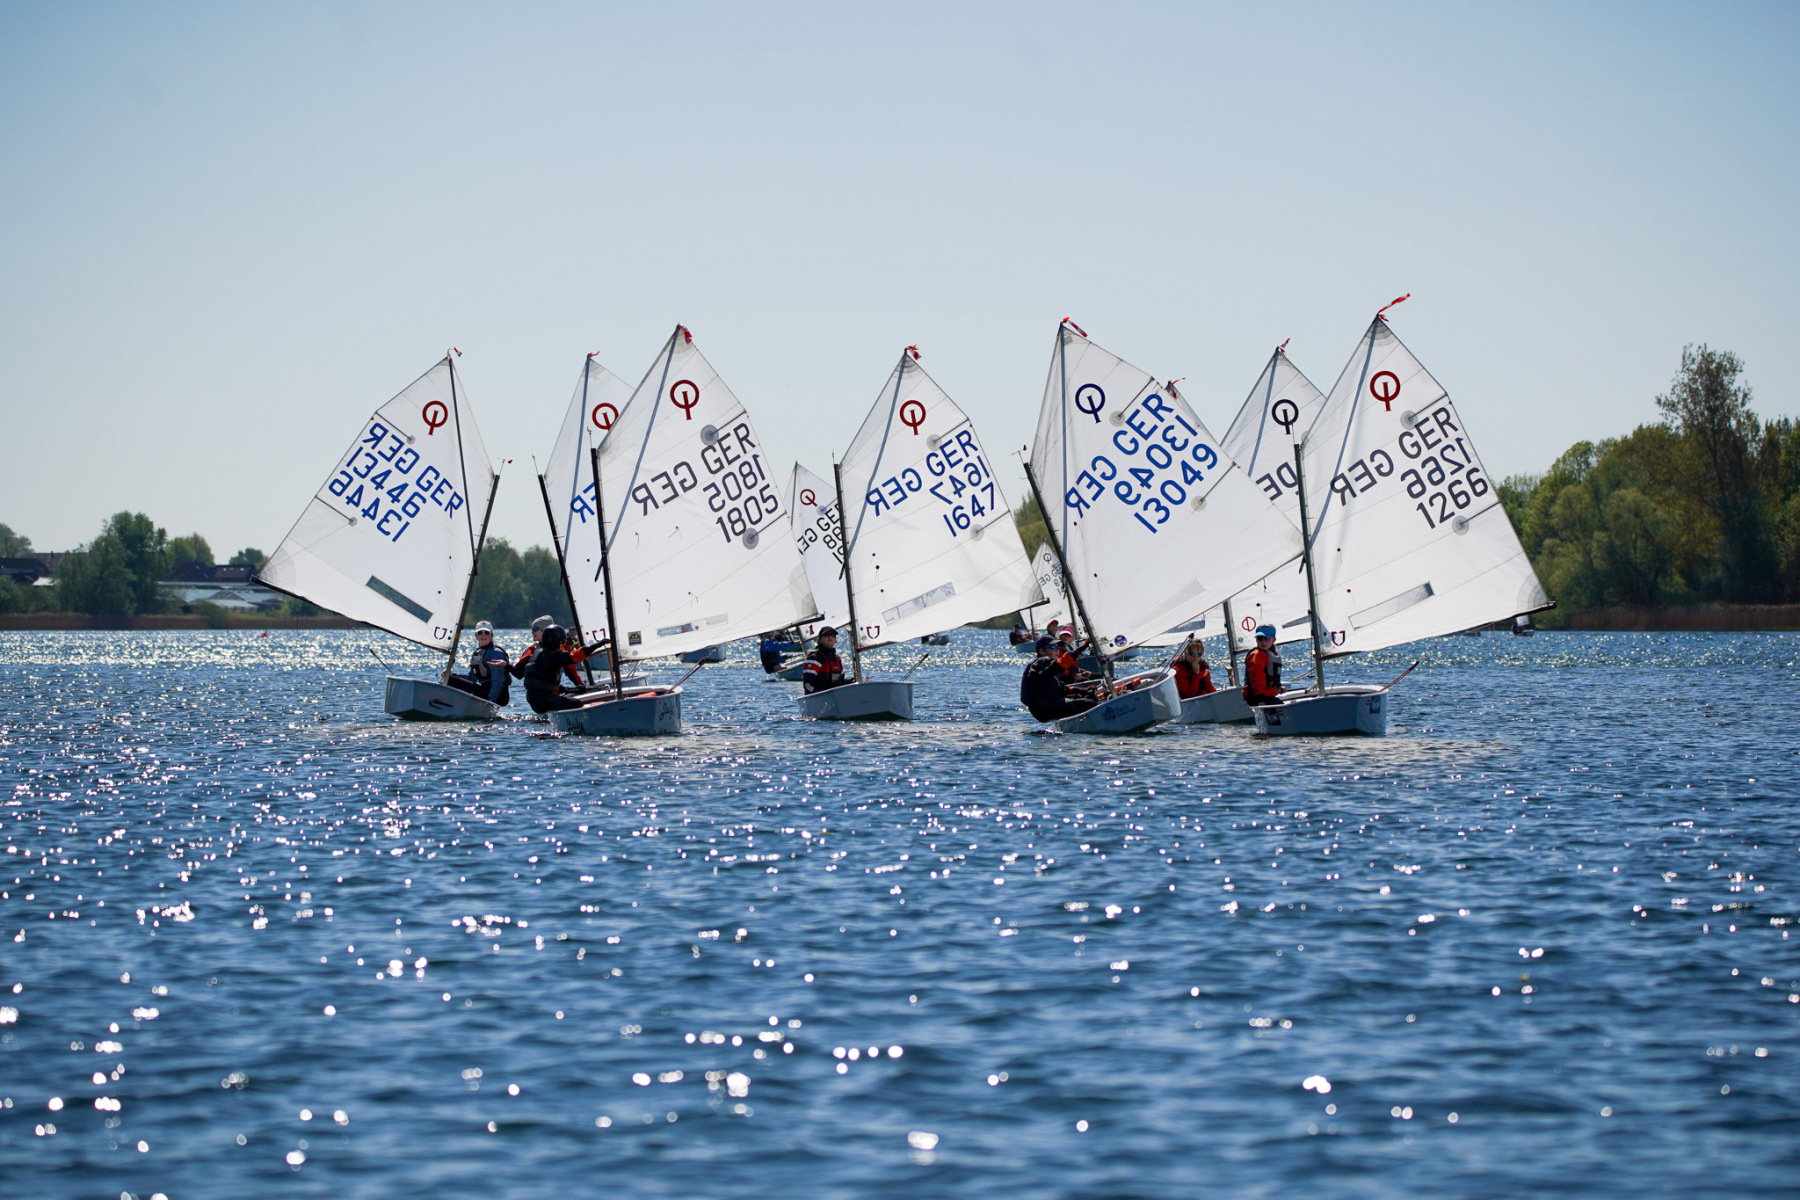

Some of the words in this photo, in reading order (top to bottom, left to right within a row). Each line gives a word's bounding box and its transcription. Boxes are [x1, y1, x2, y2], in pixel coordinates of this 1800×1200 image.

[700, 422, 756, 475] GER
[926, 429, 978, 477] GER
[1112, 393, 1174, 456] GER
[1398, 406, 1459, 460] GER
[346, 446, 427, 519] 13446
[415, 465, 464, 519] GER
[943, 481, 995, 537] 1647
[1133, 443, 1218, 534] 13049
[1416, 467, 1489, 529] 1266
[715, 483, 778, 543] 1805
